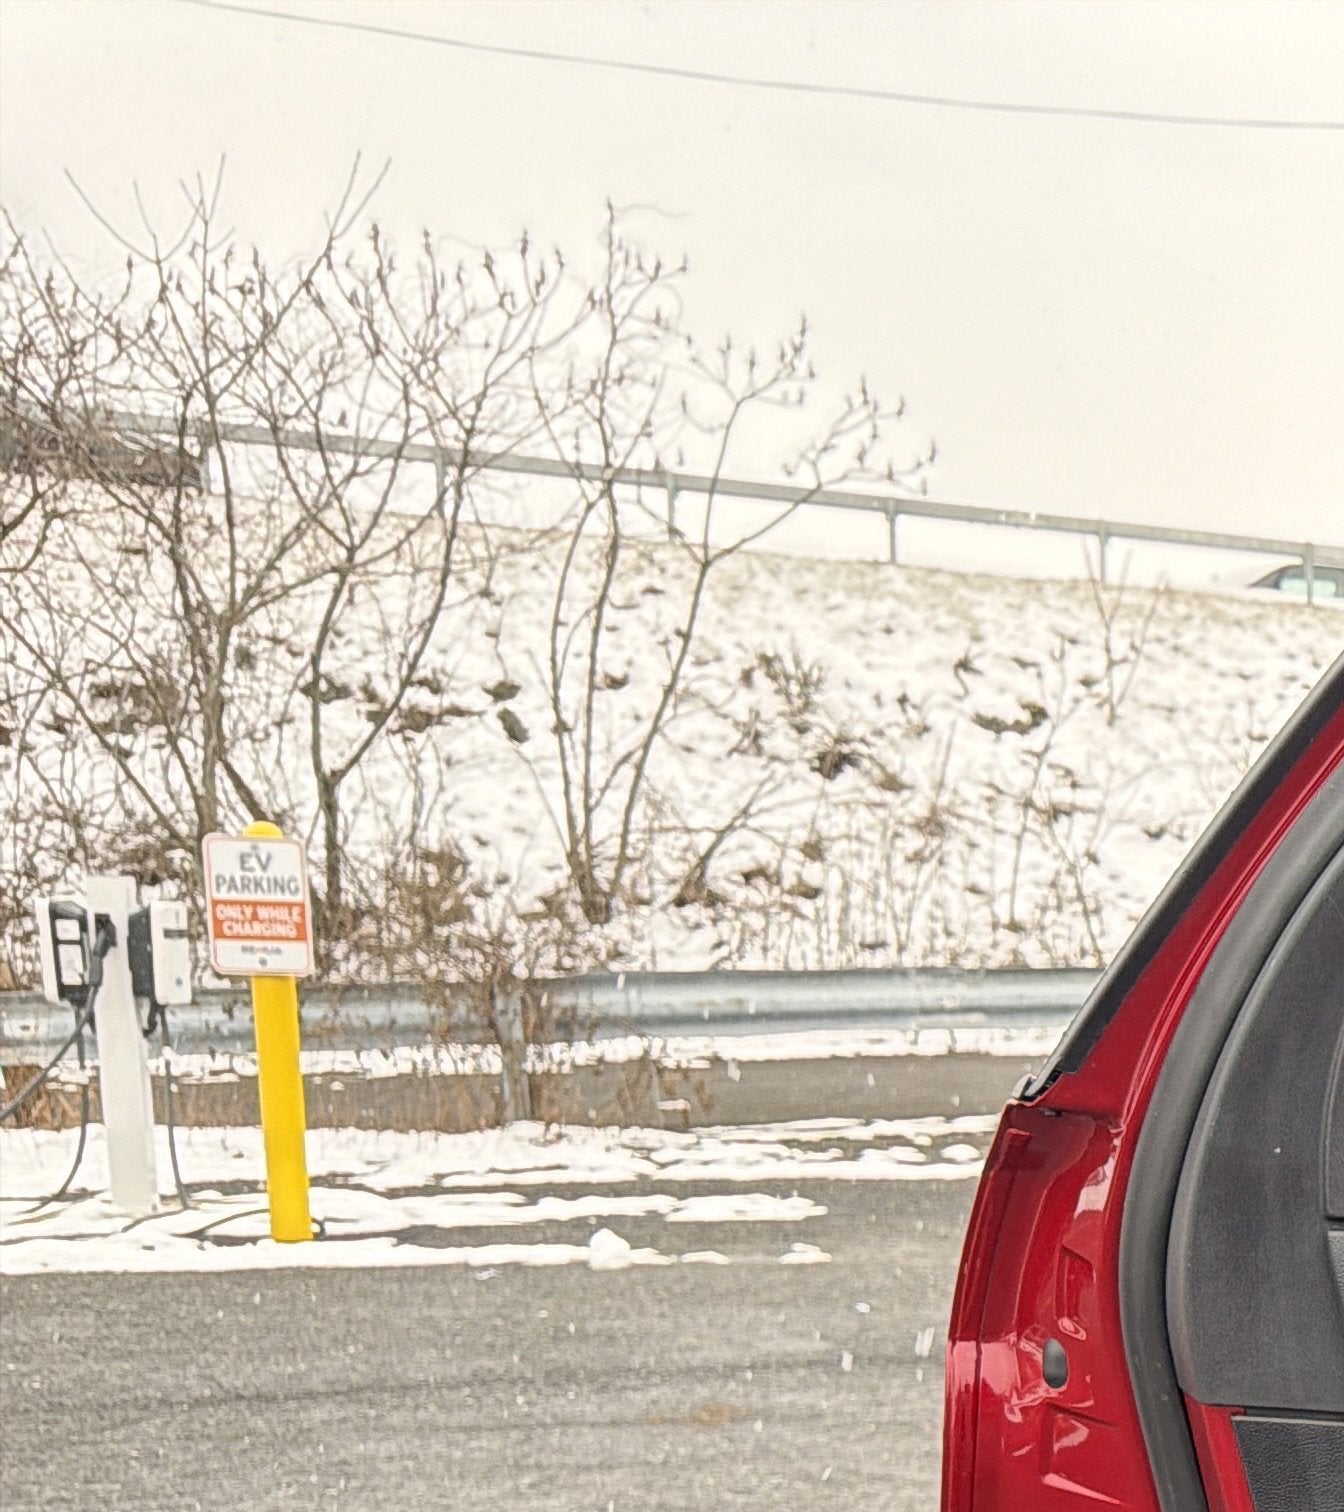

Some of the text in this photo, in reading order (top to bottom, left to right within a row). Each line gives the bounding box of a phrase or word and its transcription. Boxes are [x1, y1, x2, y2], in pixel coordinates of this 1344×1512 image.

[239, 852, 271, 873] EV
[215, 874, 299, 896] PARKING
[216, 904, 300, 923] ONLY WHILE
[222, 921, 297, 937] CHARGING
